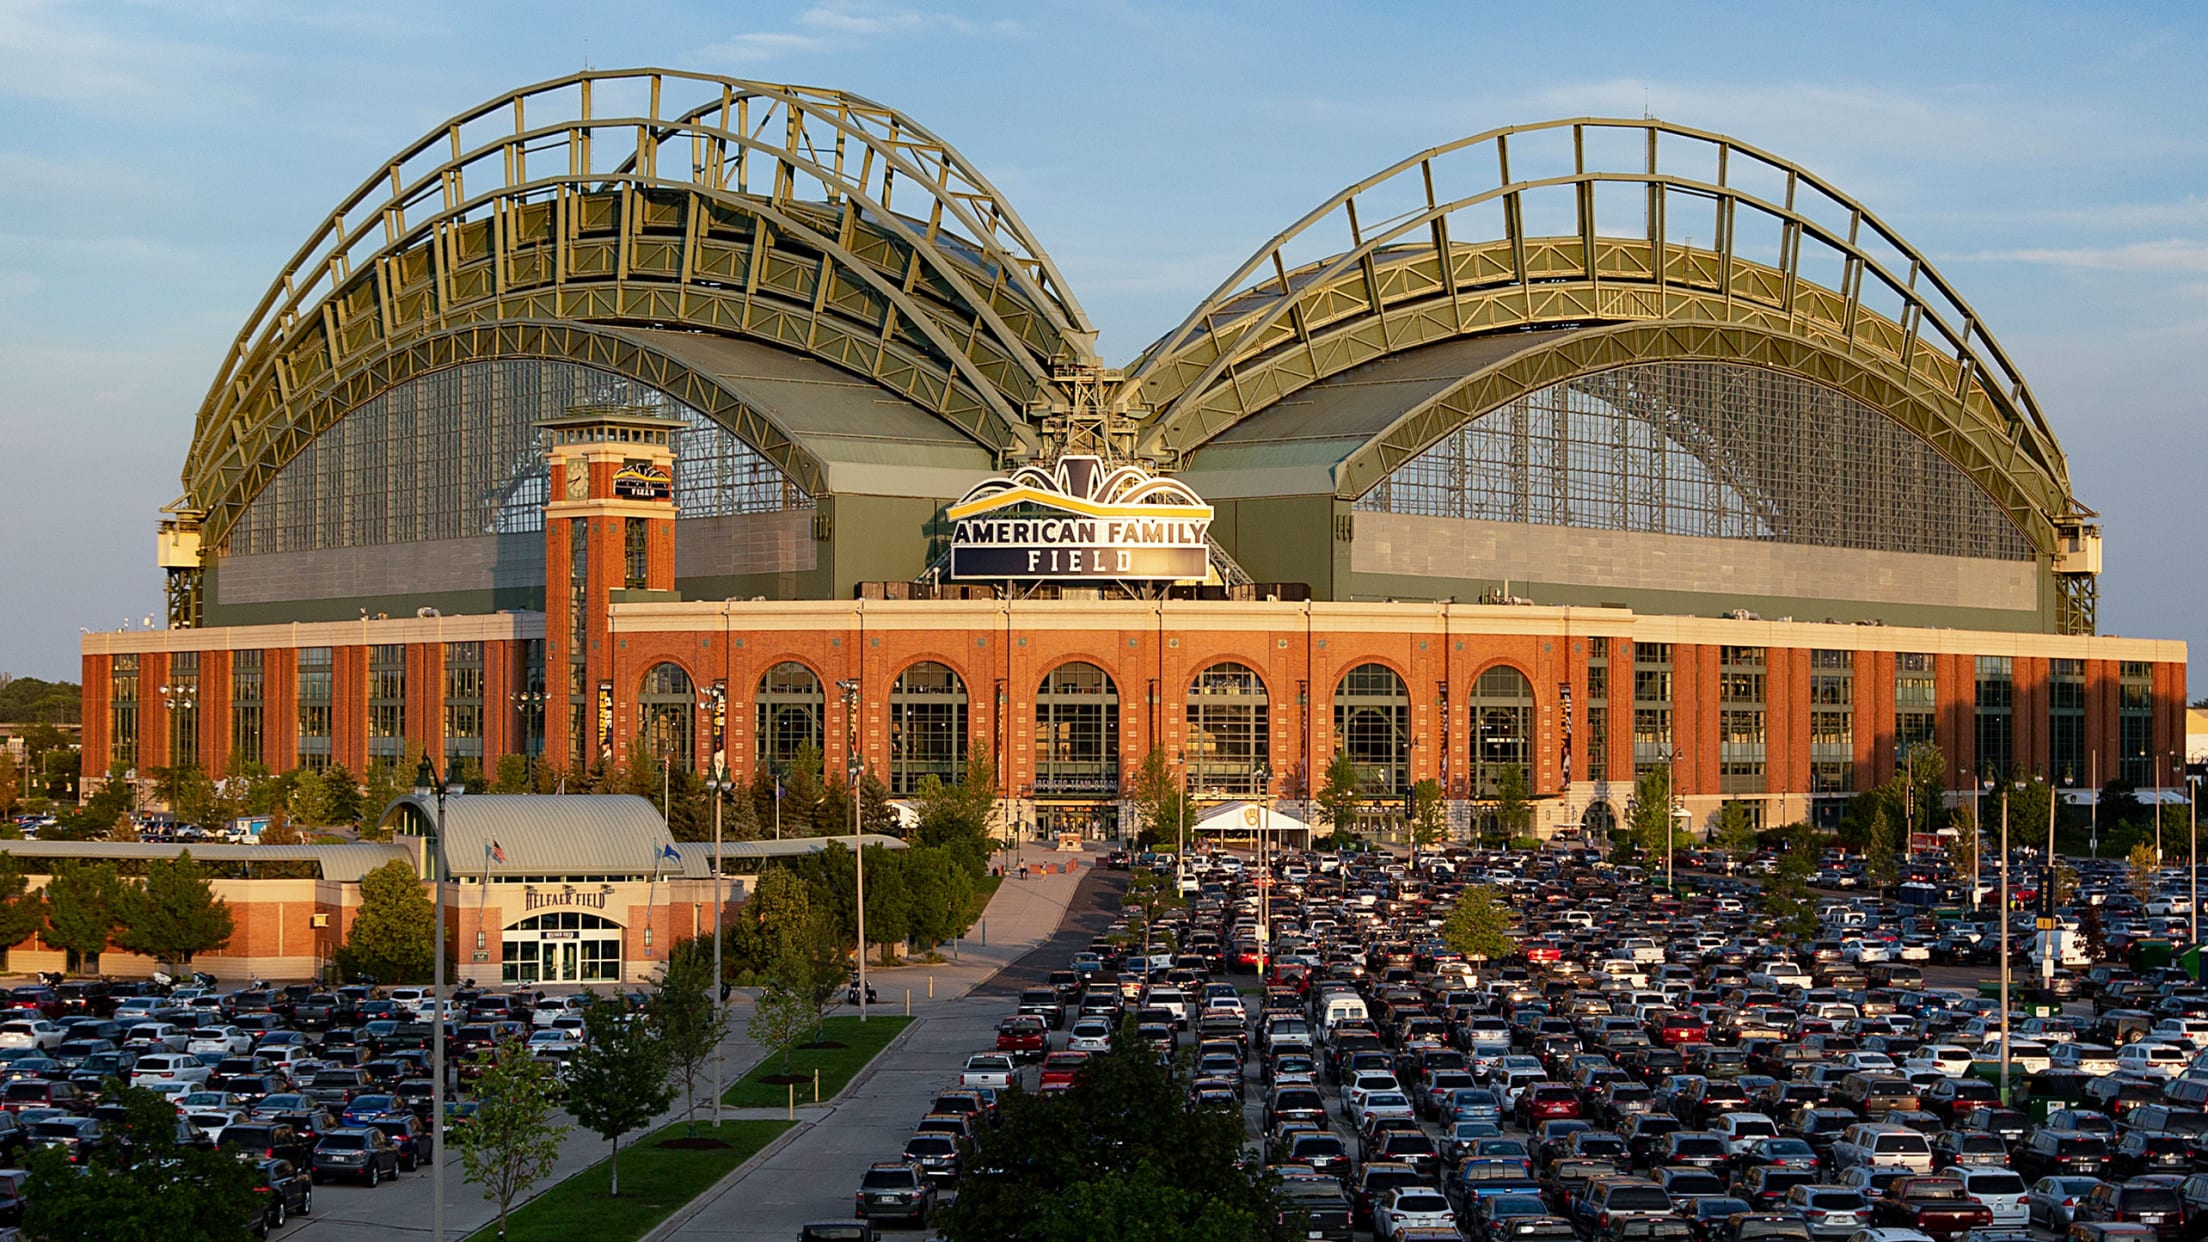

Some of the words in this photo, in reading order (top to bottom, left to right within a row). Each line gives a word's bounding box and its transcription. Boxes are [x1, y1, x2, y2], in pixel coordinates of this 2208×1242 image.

[953, 522, 1096, 543] AMERICAN
[1108, 522, 1206, 544] FAMILY
[1027, 550, 1131, 572] FIELD
[576, 892, 605, 909] FIELD
